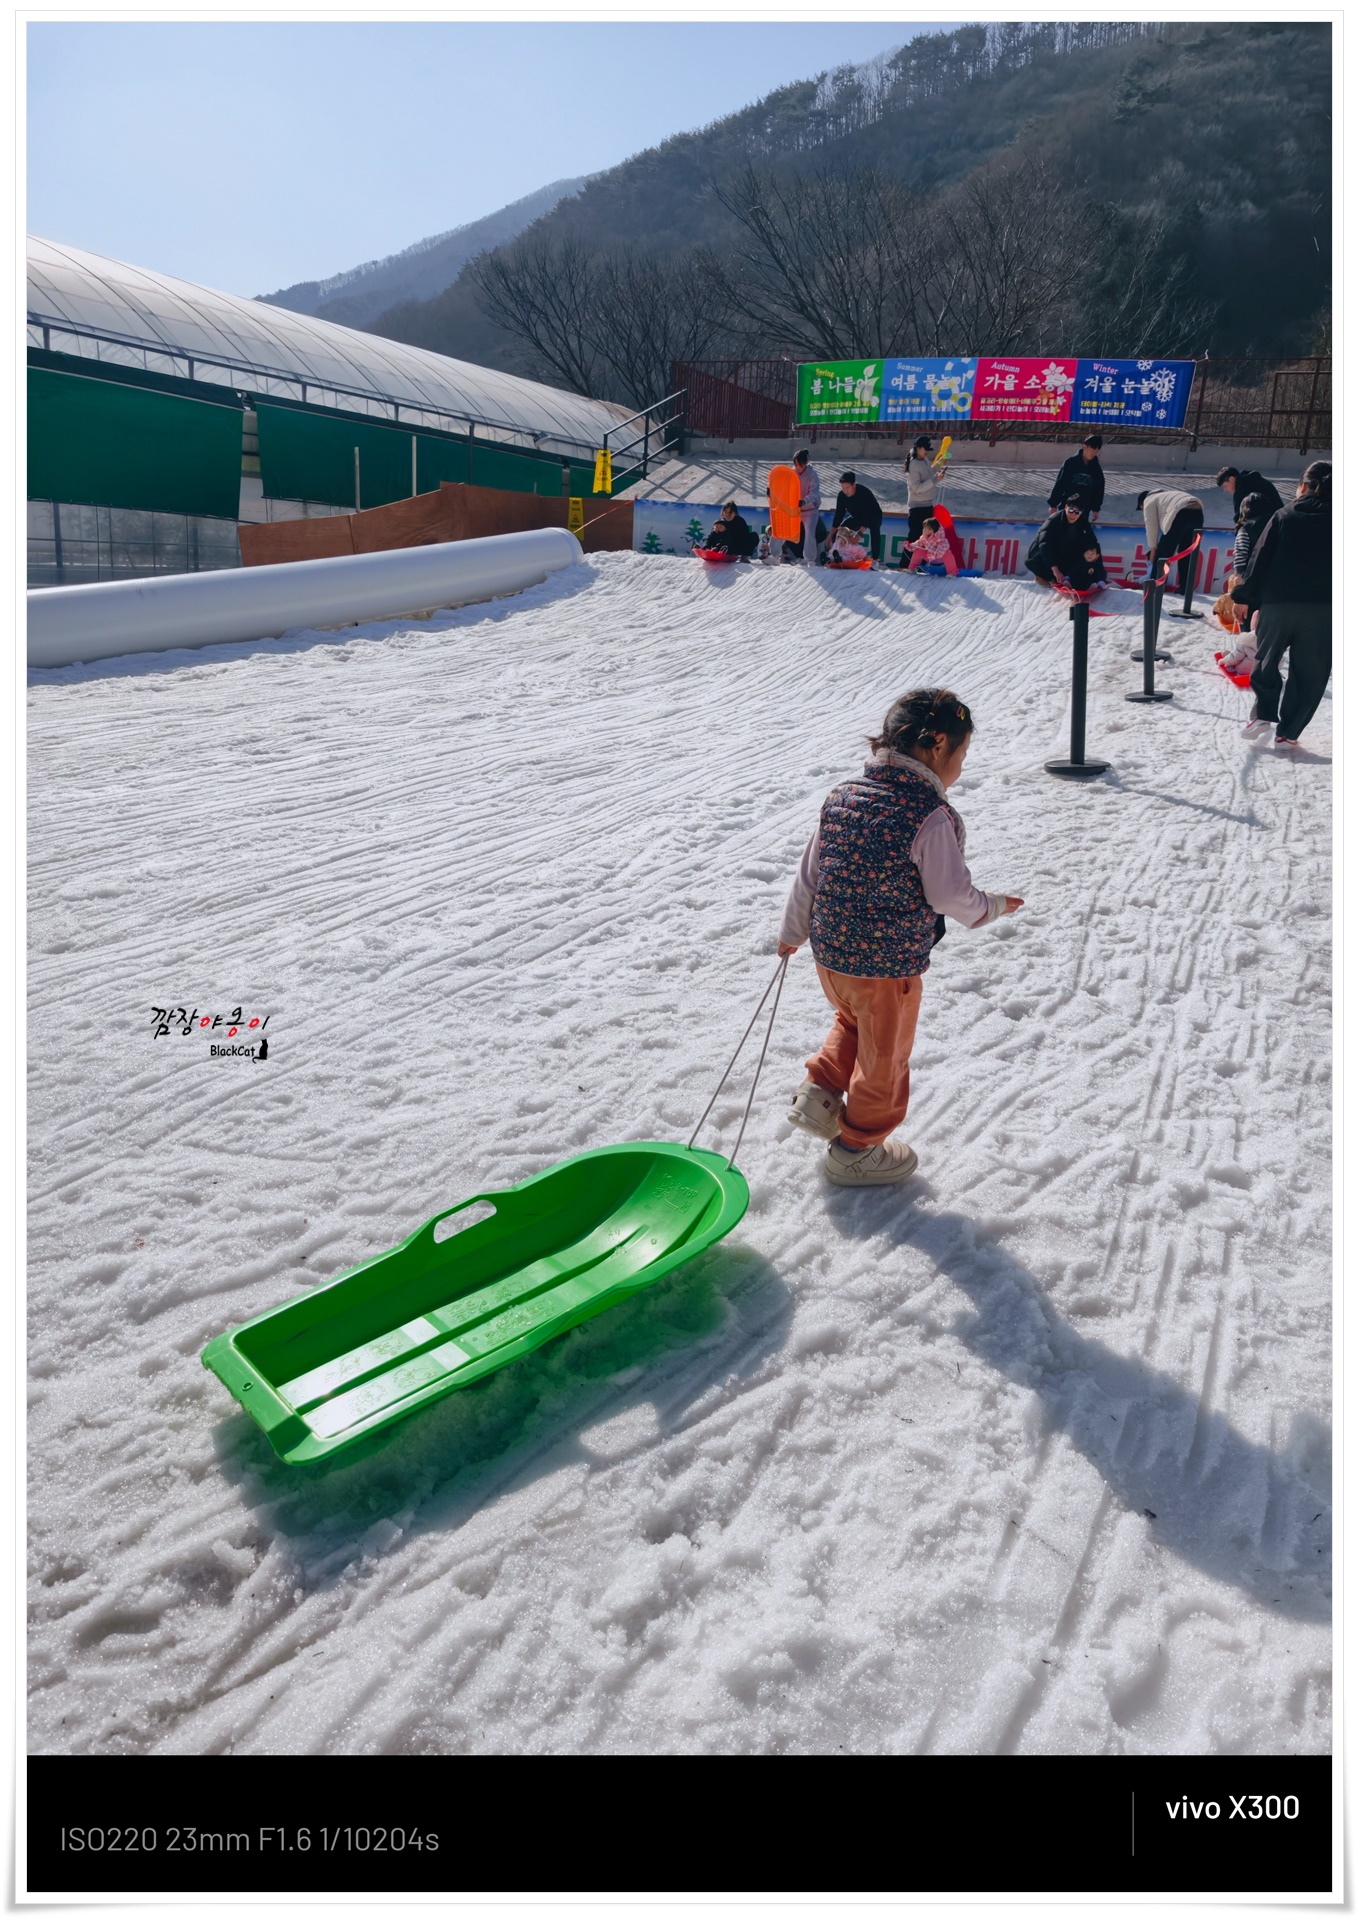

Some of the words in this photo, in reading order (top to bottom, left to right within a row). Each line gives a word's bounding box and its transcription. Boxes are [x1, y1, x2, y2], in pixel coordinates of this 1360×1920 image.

[815, 368, 835, 379] Spring
[896, 362, 924, 373] Summer
[991, 361, 1020, 373] Autumn
[1093, 363, 1119, 375] Winter
[810, 378, 824, 395] 봄
[891, 374, 918, 391] 여름
[923, 373, 966, 391] 물놀이
[983, 373, 1019, 391] 가을
[1084, 375, 1116, 394] 겨울
[1121, 377, 1170, 395] 눈놀이
